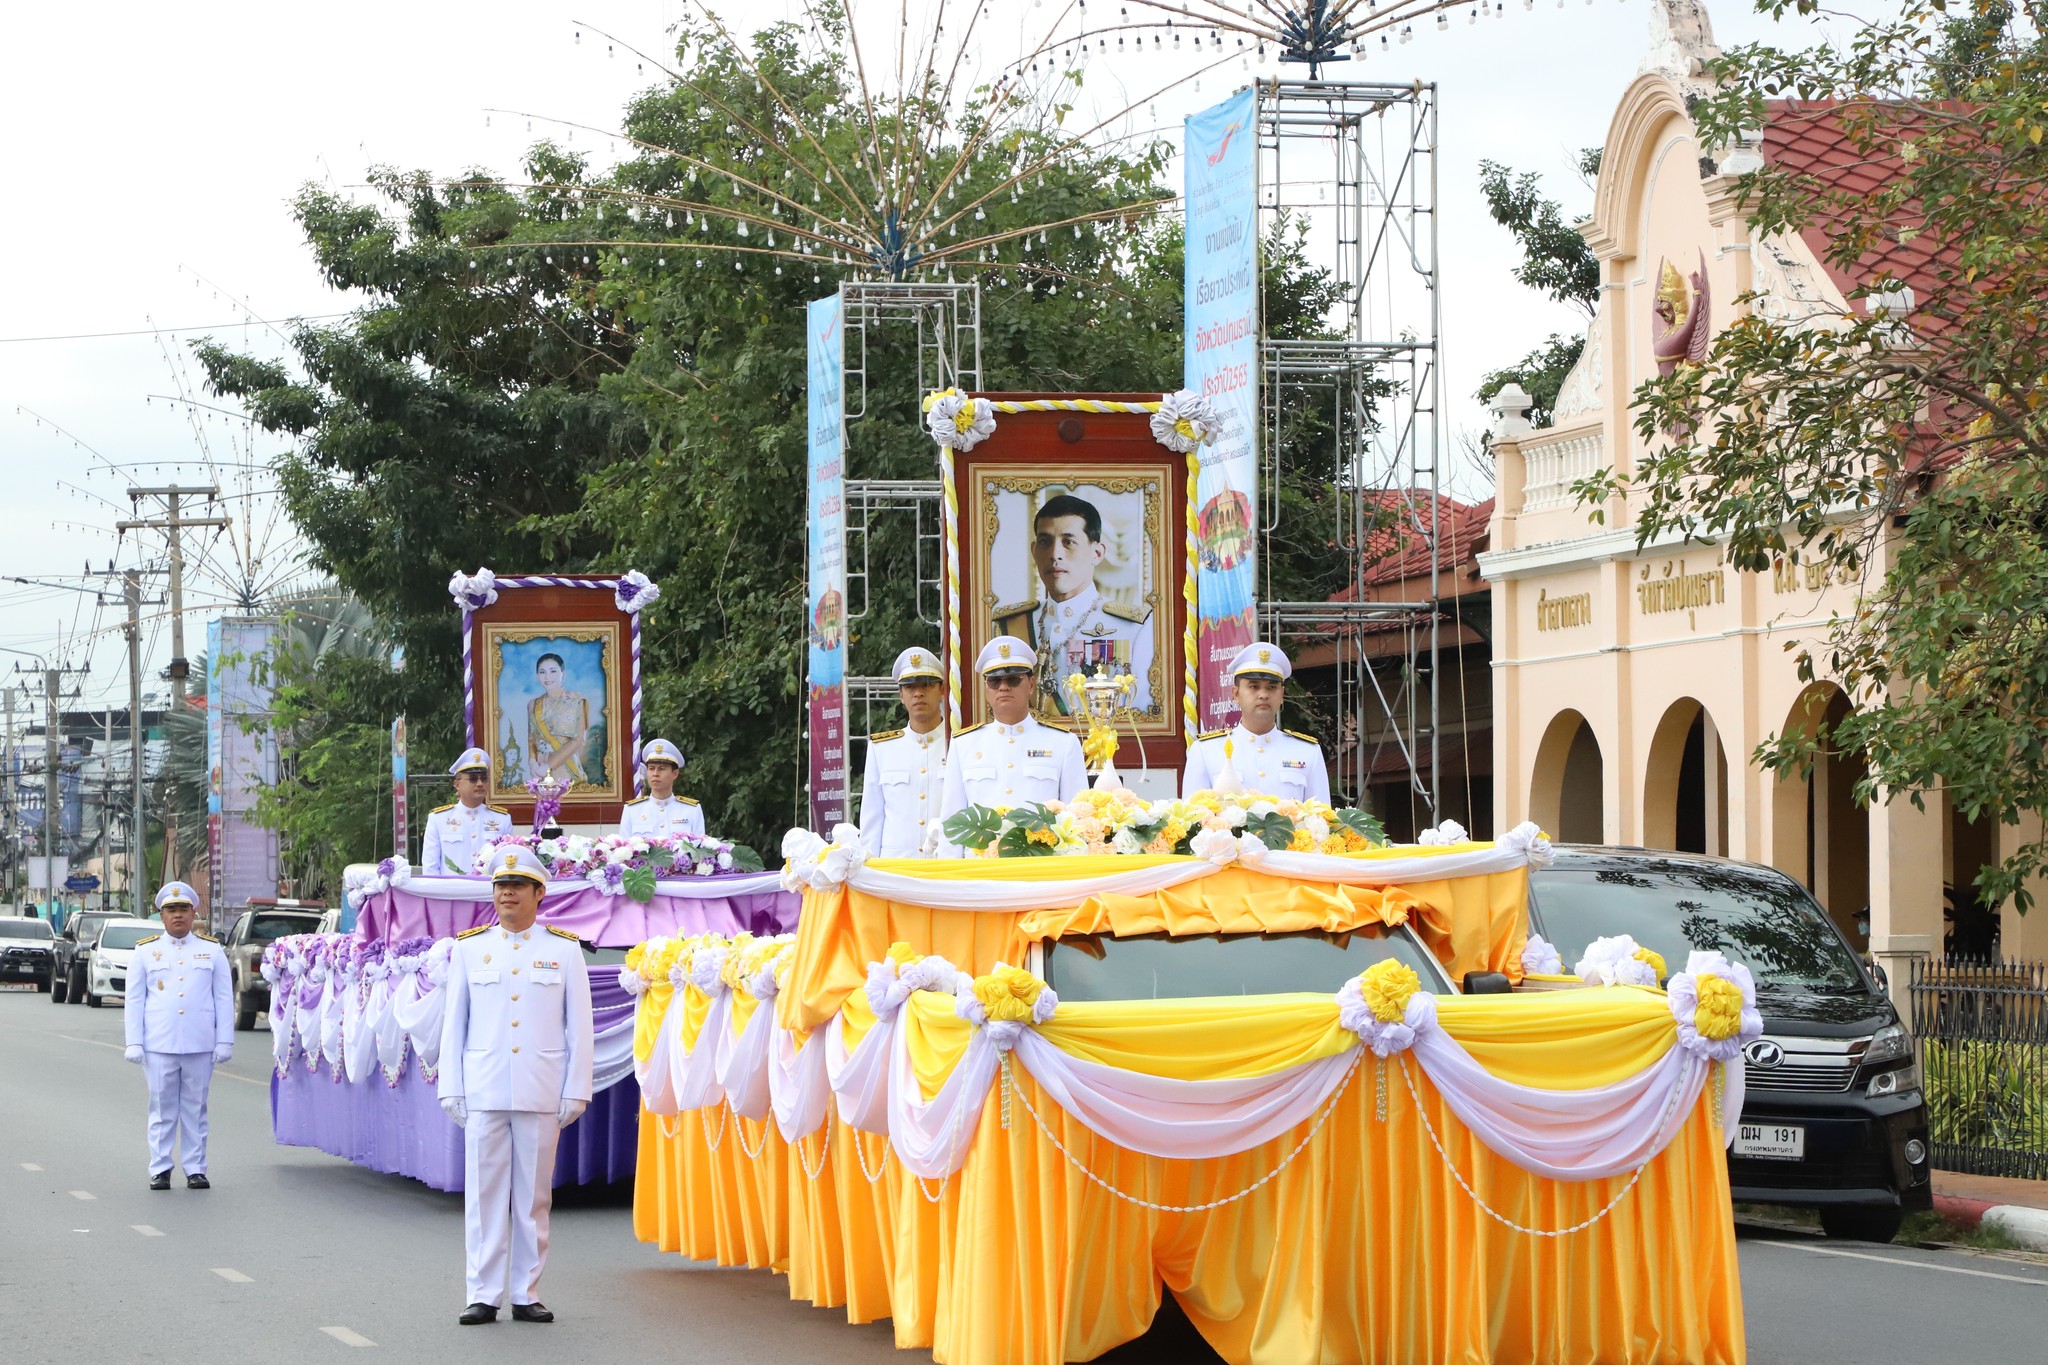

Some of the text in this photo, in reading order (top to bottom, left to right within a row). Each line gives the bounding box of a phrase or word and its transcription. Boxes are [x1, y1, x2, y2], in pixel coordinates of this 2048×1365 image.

[1205, 215, 1243, 255] งานแข่งขัน
[1196, 257, 1250, 306] เรือยาวประเพณี
[1195, 306, 1251, 352] จังหวัดปทุมธานี
[1538, 588, 1592, 632] ศาลากลาง
[1744, 1145, 1793, 1154] กรุงเทพมหานคร
[1774, 1128, 1797, 1143] 191
